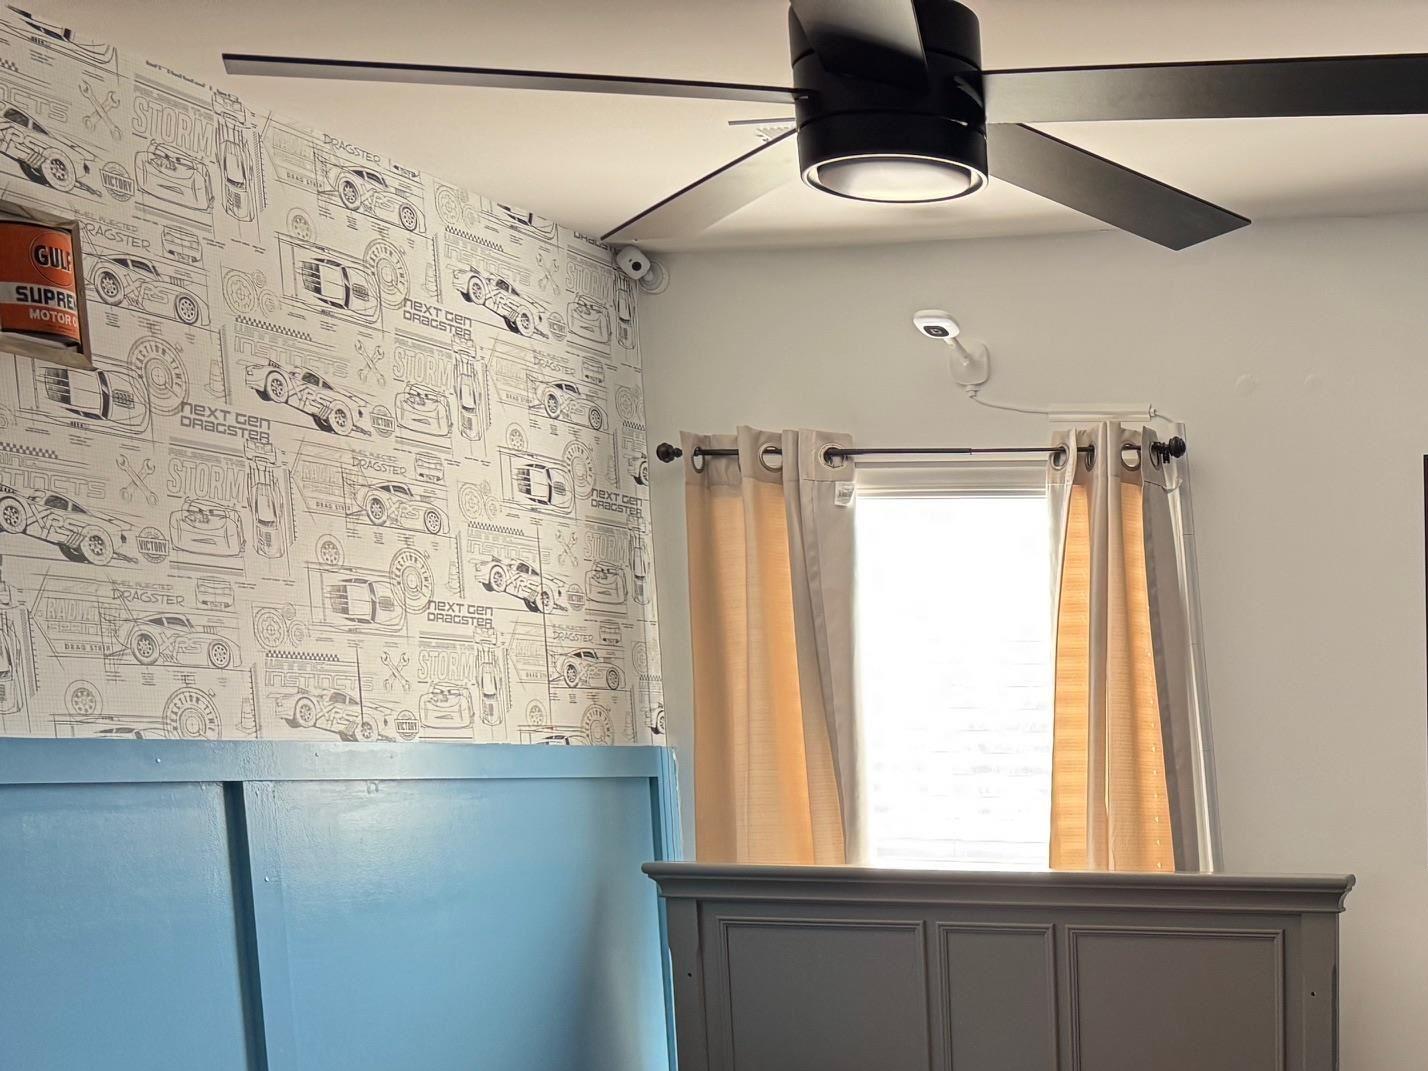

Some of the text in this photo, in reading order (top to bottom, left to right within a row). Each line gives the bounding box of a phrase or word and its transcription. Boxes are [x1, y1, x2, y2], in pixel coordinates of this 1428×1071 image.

[132, 96, 214, 157] STORM
[323, 134, 381, 165] DRAGSTER
[102, 174, 133, 194] VICTORY
[83, 222, 151, 253] RAGSTER
[16, 286, 77, 311] SUPRE
[29, 308, 71, 325] MOTOR
[393, 346, 452, 387] STORM
[352, 456, 407, 478] DRAGSTER
[167, 458, 246, 503] STORM
[138, 538, 169, 555] VICTORY
[112, 588, 185, 607] DRAGSTER
[553, 631, 593, 643] DRAGSTER
[417, 649, 476, 681] STORM
